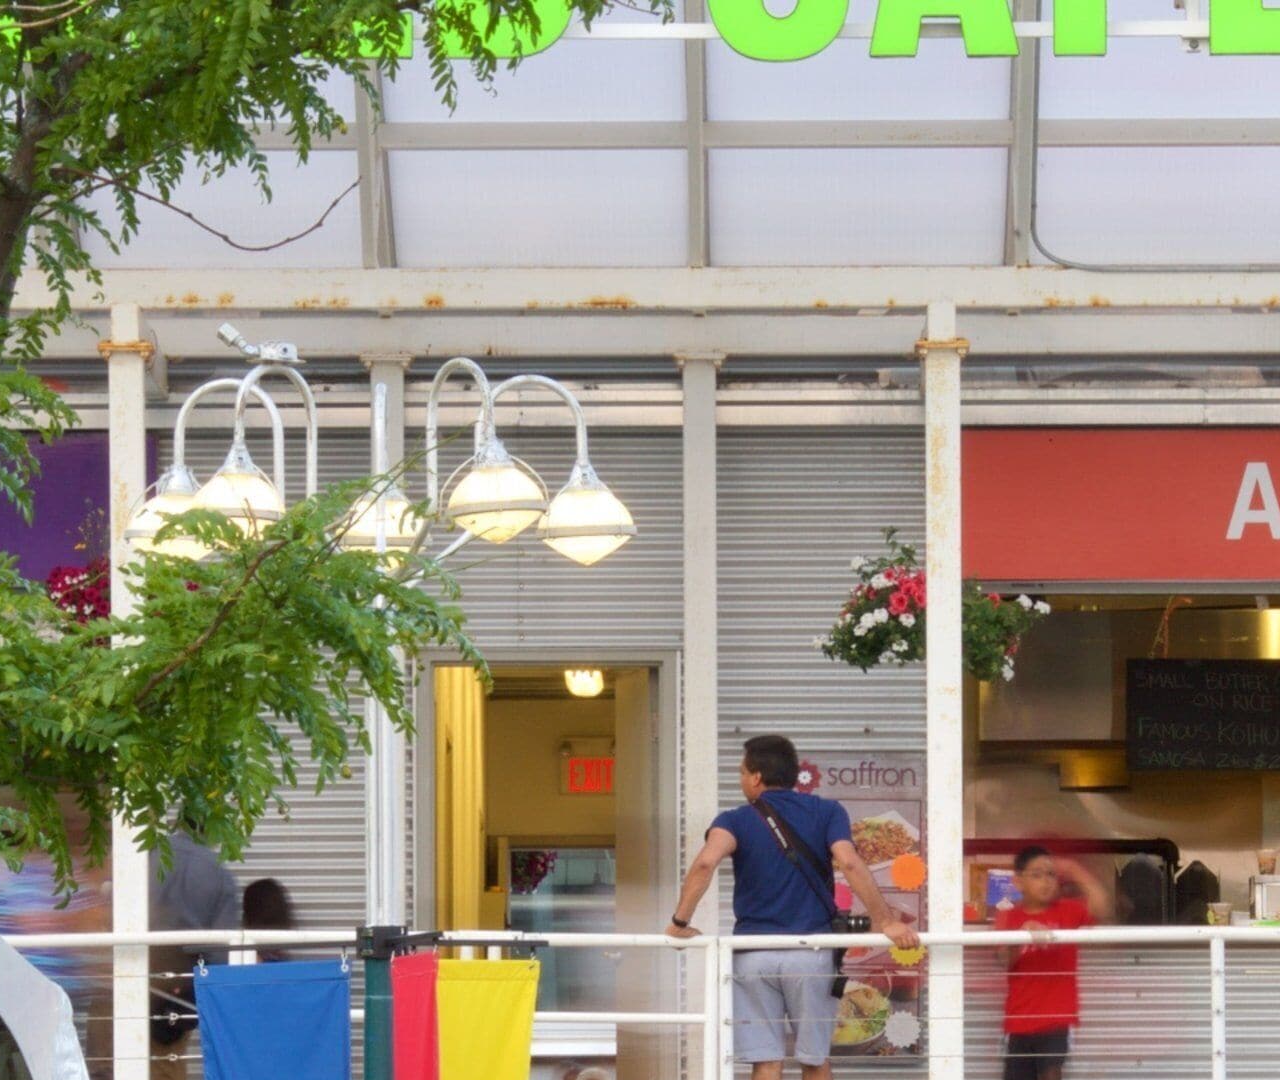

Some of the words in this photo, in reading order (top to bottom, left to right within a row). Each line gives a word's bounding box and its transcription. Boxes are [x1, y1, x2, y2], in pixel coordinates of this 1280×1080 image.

[1192, 691, 1224, 710] ON
[1232, 692, 1273, 712] RICE
[1137, 716, 1212, 742] FAMOUS
[1137, 746, 1206, 768] SAMOSA
[568, 757, 616, 793] EXIT
[827, 760, 917, 787] saffron
